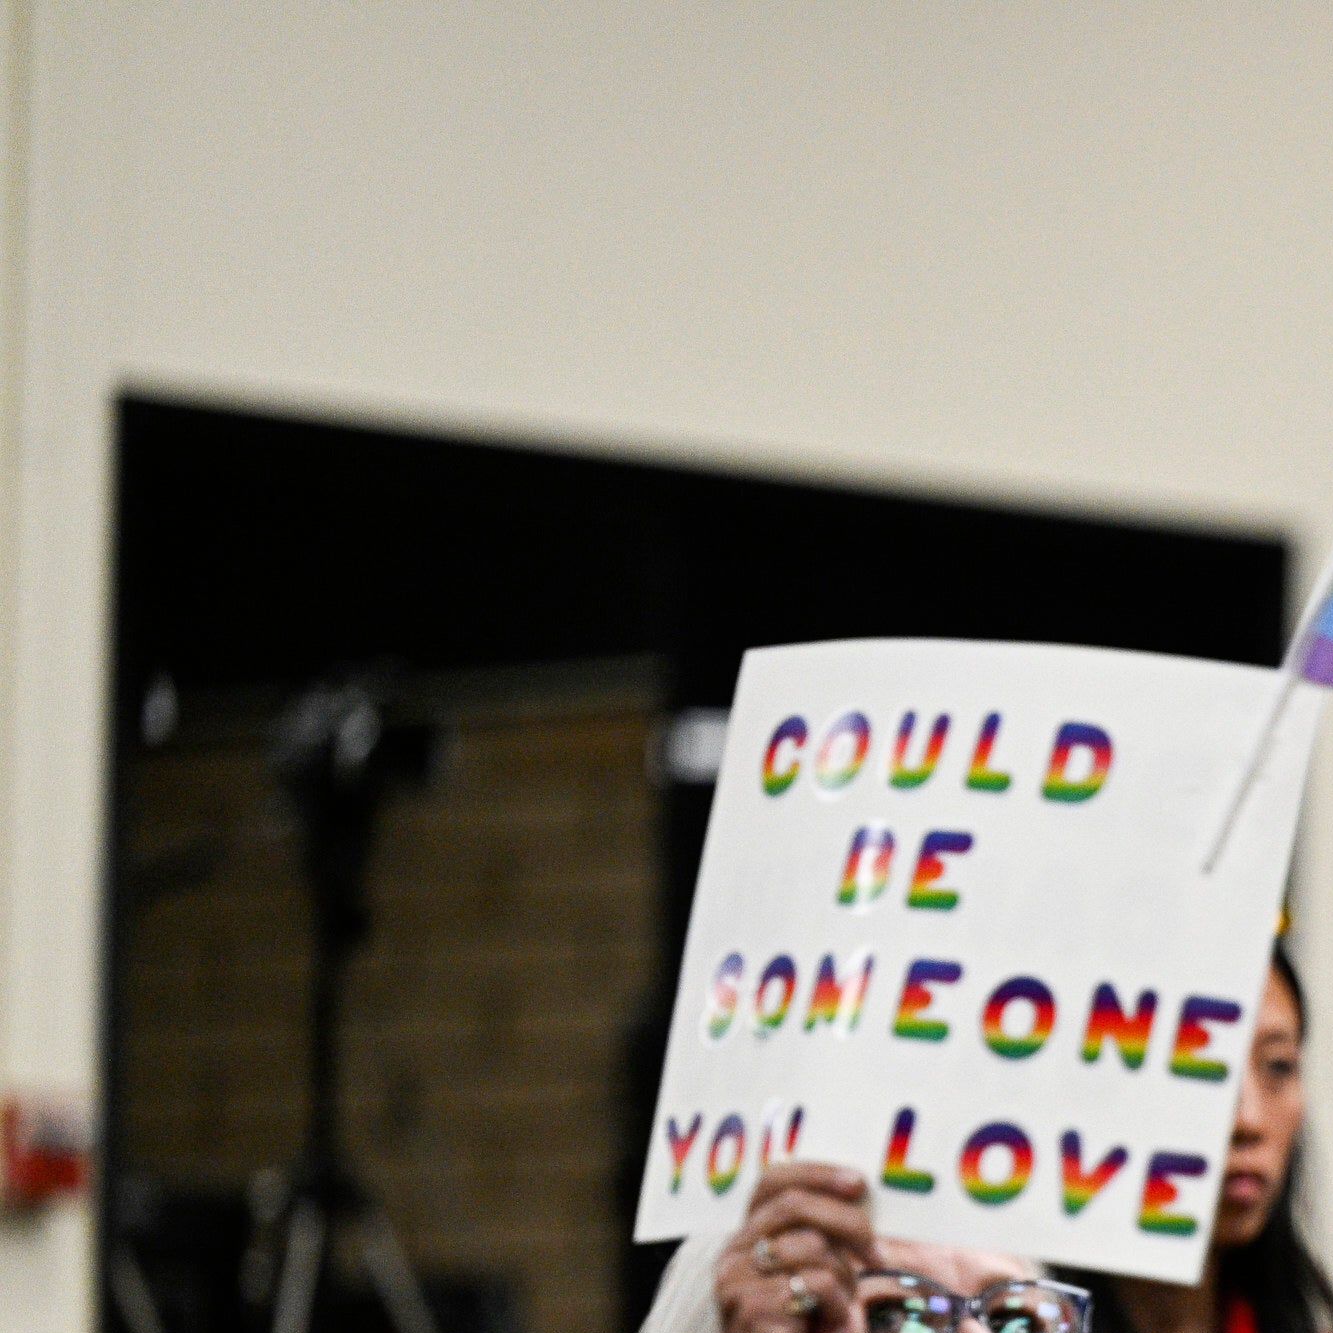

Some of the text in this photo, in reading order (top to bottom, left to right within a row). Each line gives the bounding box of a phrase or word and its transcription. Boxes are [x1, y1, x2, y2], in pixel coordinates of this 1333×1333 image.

[762, 711, 1114, 803] COULD
[837, 825, 973, 909] BE
[707, 953, 1243, 1082] SOMEONE
[881, 1107, 1208, 1236] LOVE
